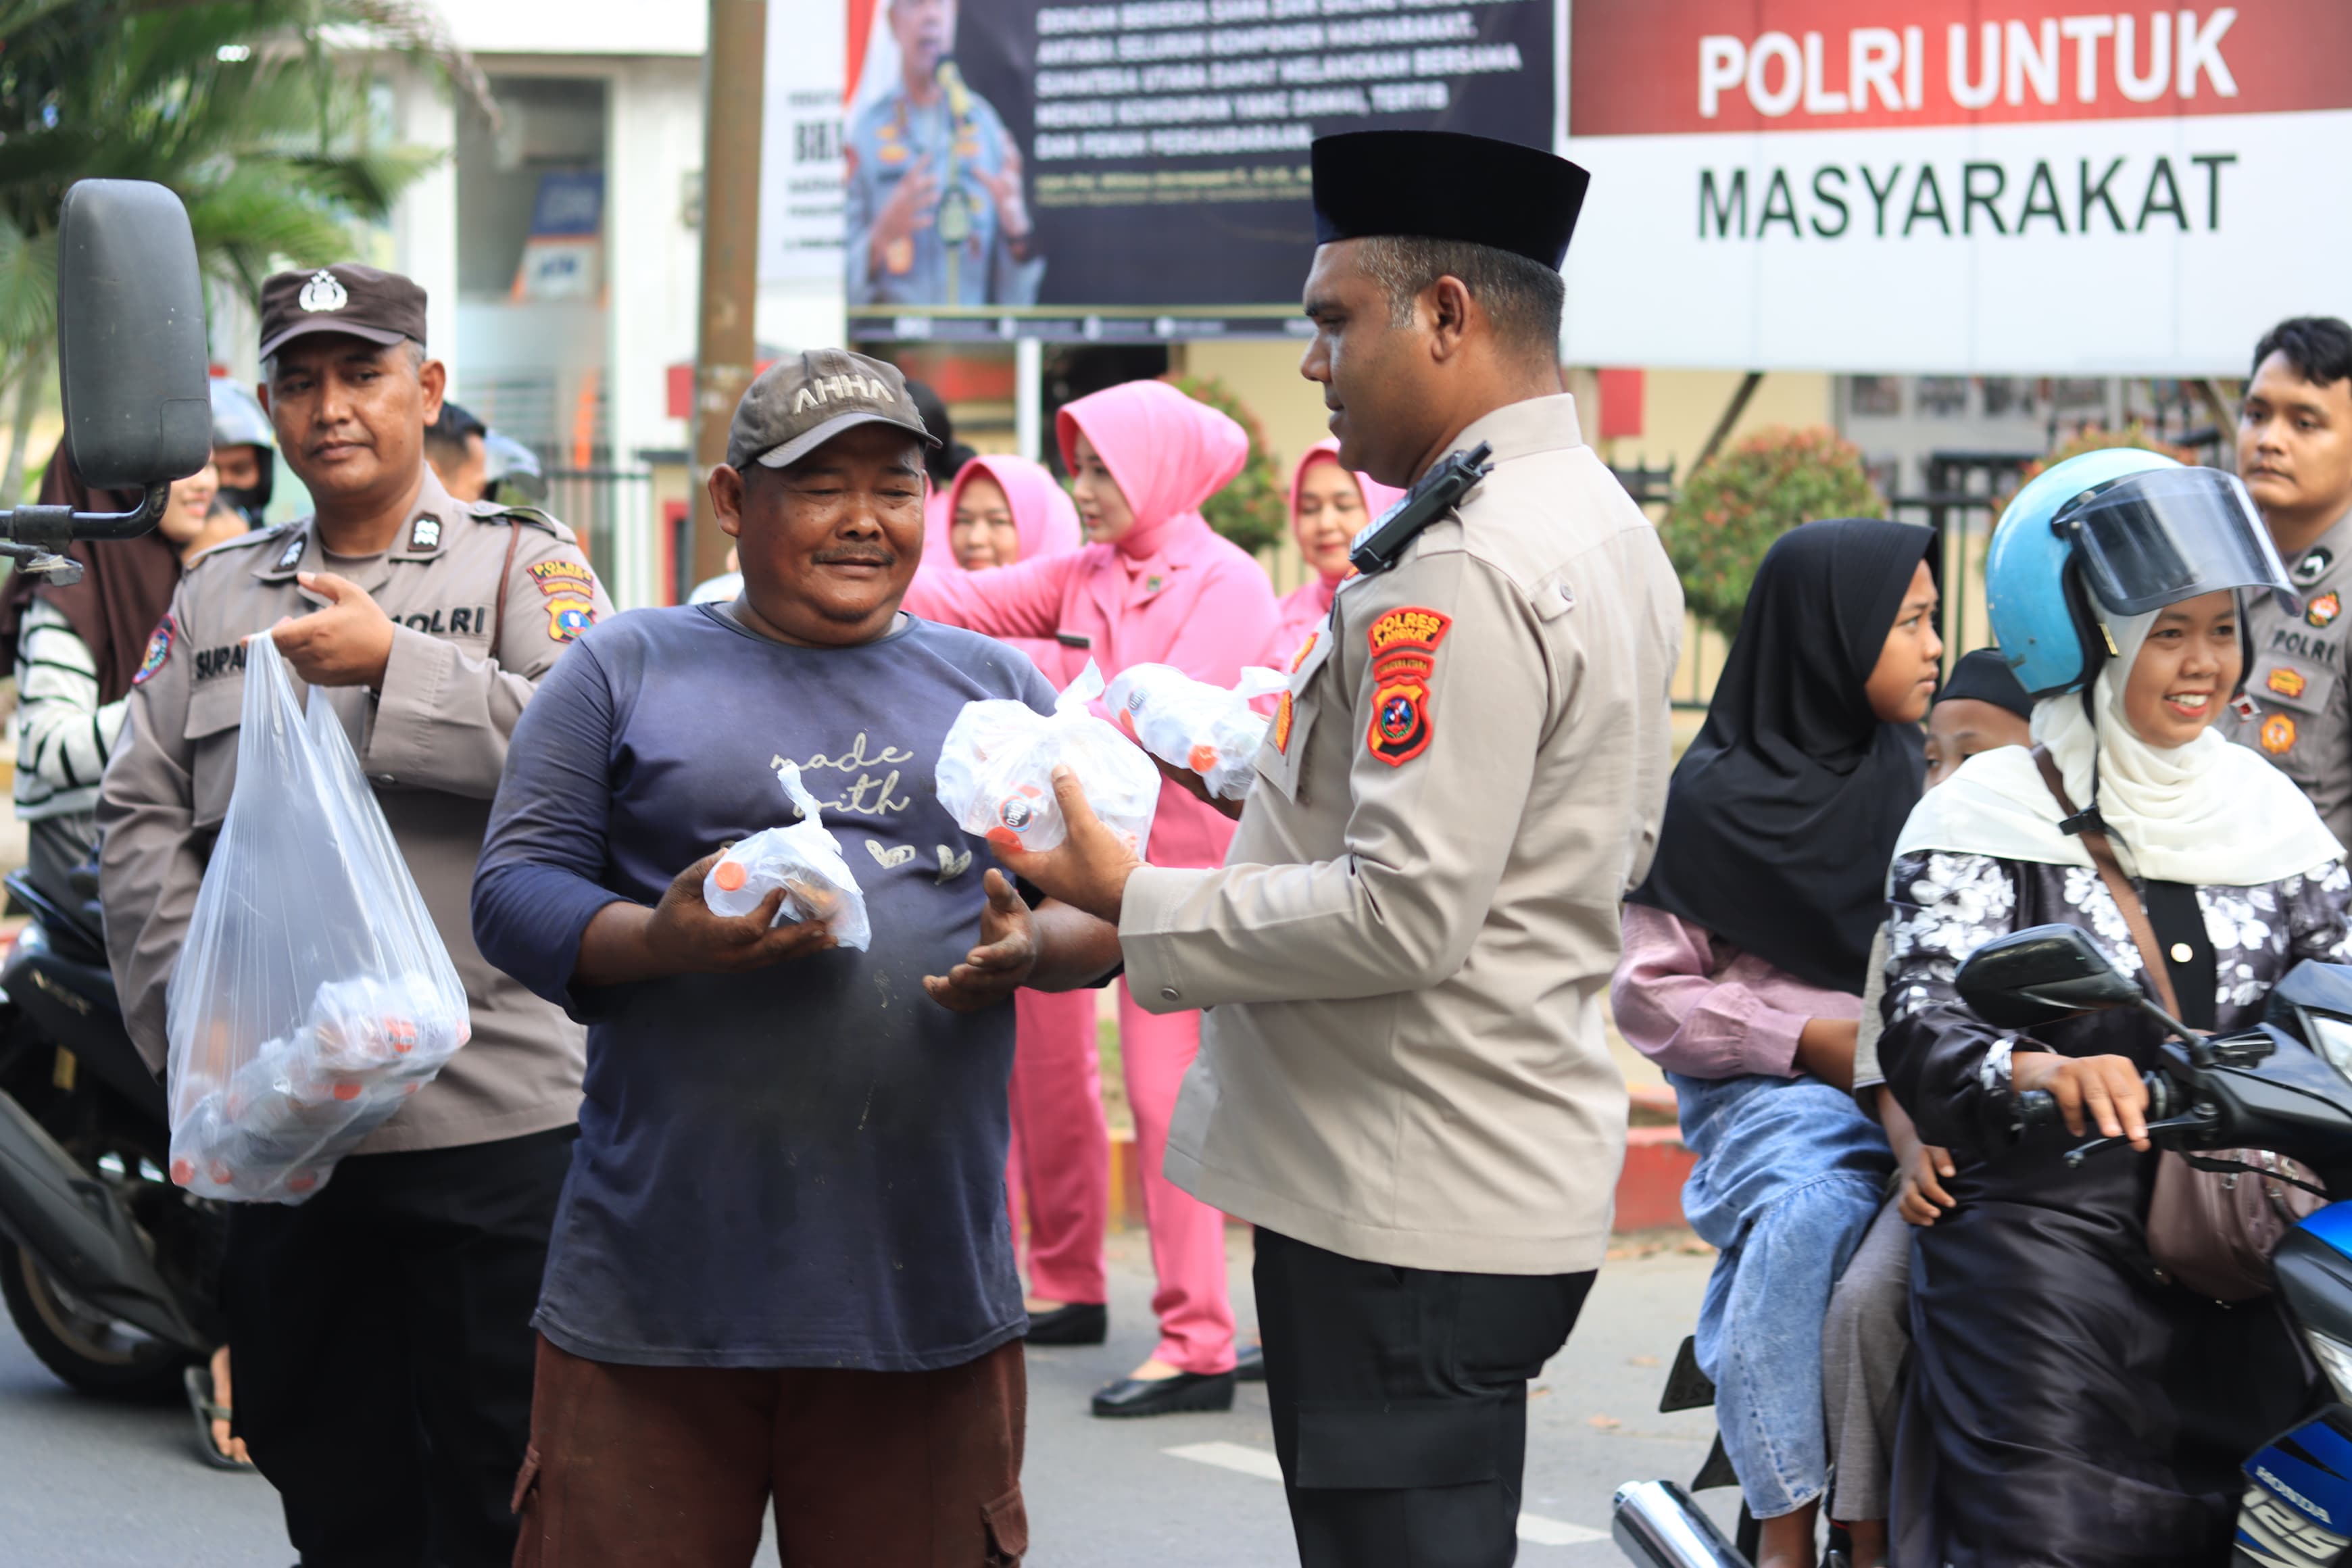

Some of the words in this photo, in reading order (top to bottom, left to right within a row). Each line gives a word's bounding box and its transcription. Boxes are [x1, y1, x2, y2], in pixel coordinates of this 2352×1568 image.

[1698, 26, 1924, 118] POLRI
[1948, 7, 2239, 110] UNTUK
[1371, 81, 1450, 112] TERTIB
[1698, 155, 2237, 239] MASYARAKAT
[793, 374, 896, 416] AHHA
[391, 606, 485, 634] OLRI
[1373, 612, 1441, 641] POLRES
[195, 643, 247, 681] SUPA
[2272, 629, 2336, 662] POLRI
[2255, 1465, 2333, 1525] HONDA
